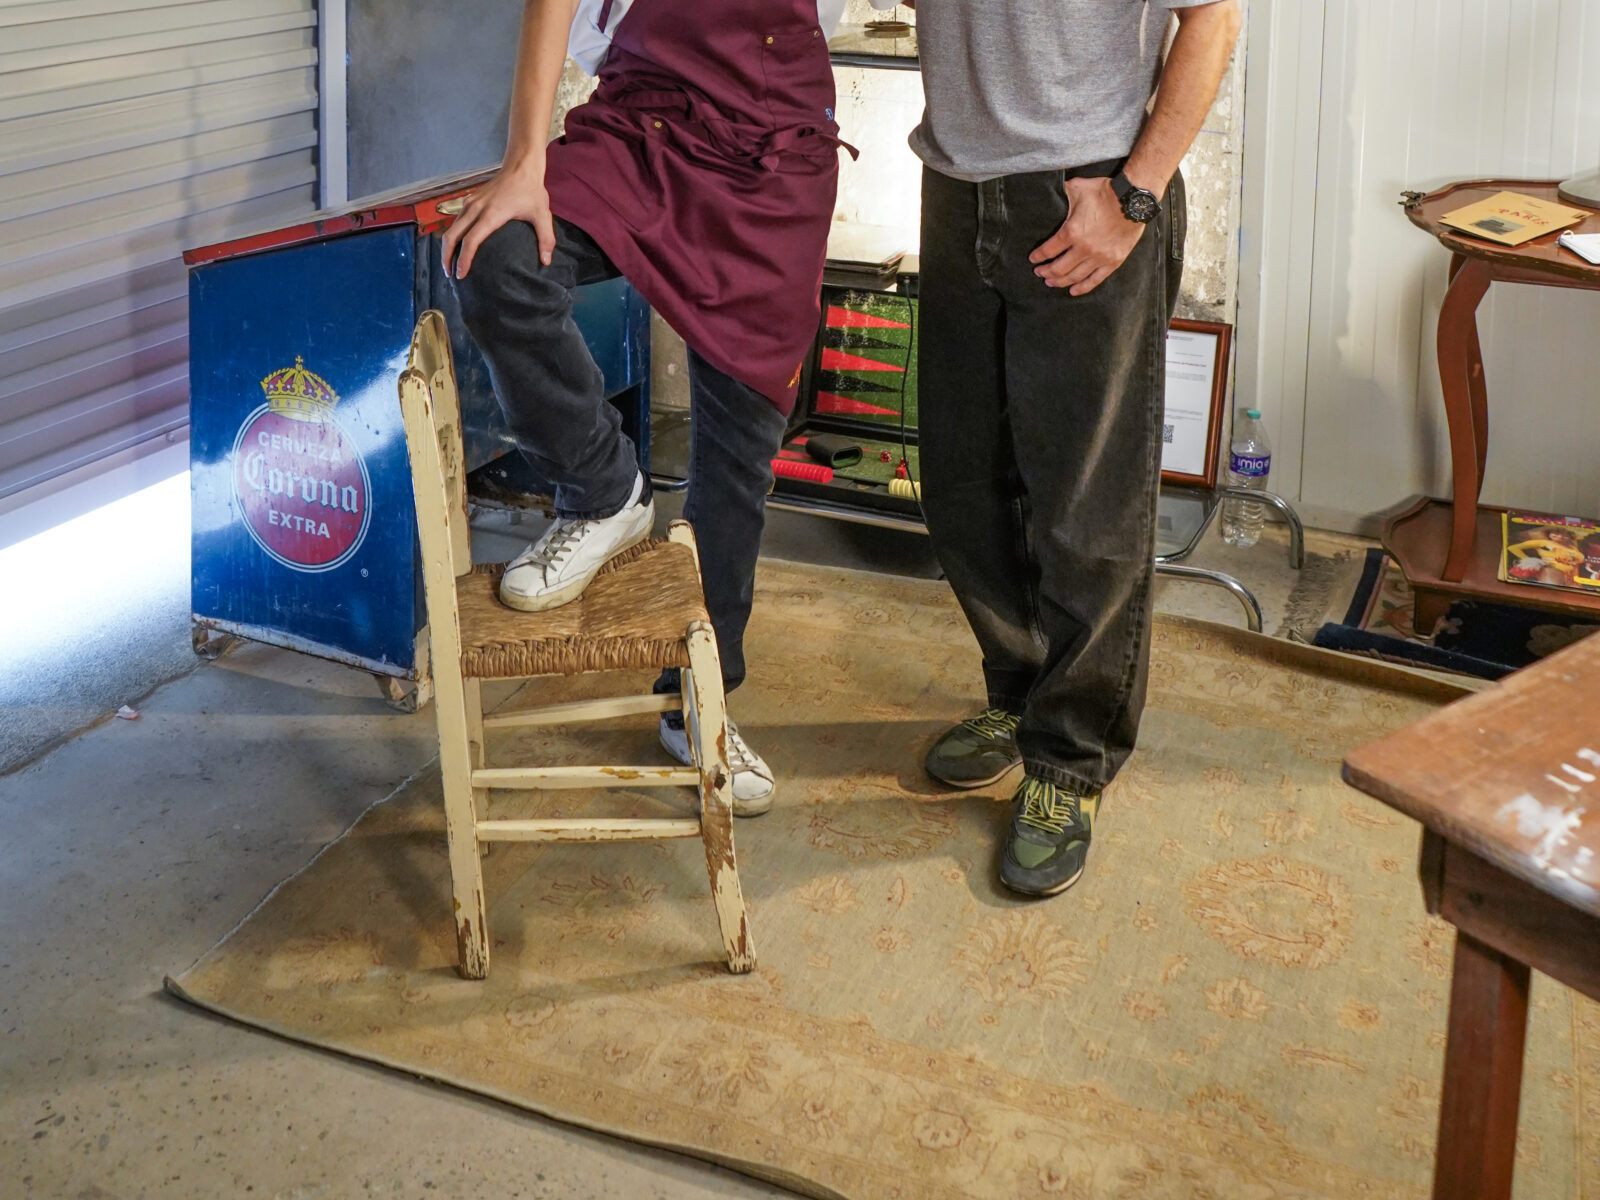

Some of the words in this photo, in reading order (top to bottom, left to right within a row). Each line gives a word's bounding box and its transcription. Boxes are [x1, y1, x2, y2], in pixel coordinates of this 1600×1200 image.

[257, 431, 343, 465] CERVEZA
[242, 451, 359, 514] Corona
[268, 509, 331, 539] EXTRA
